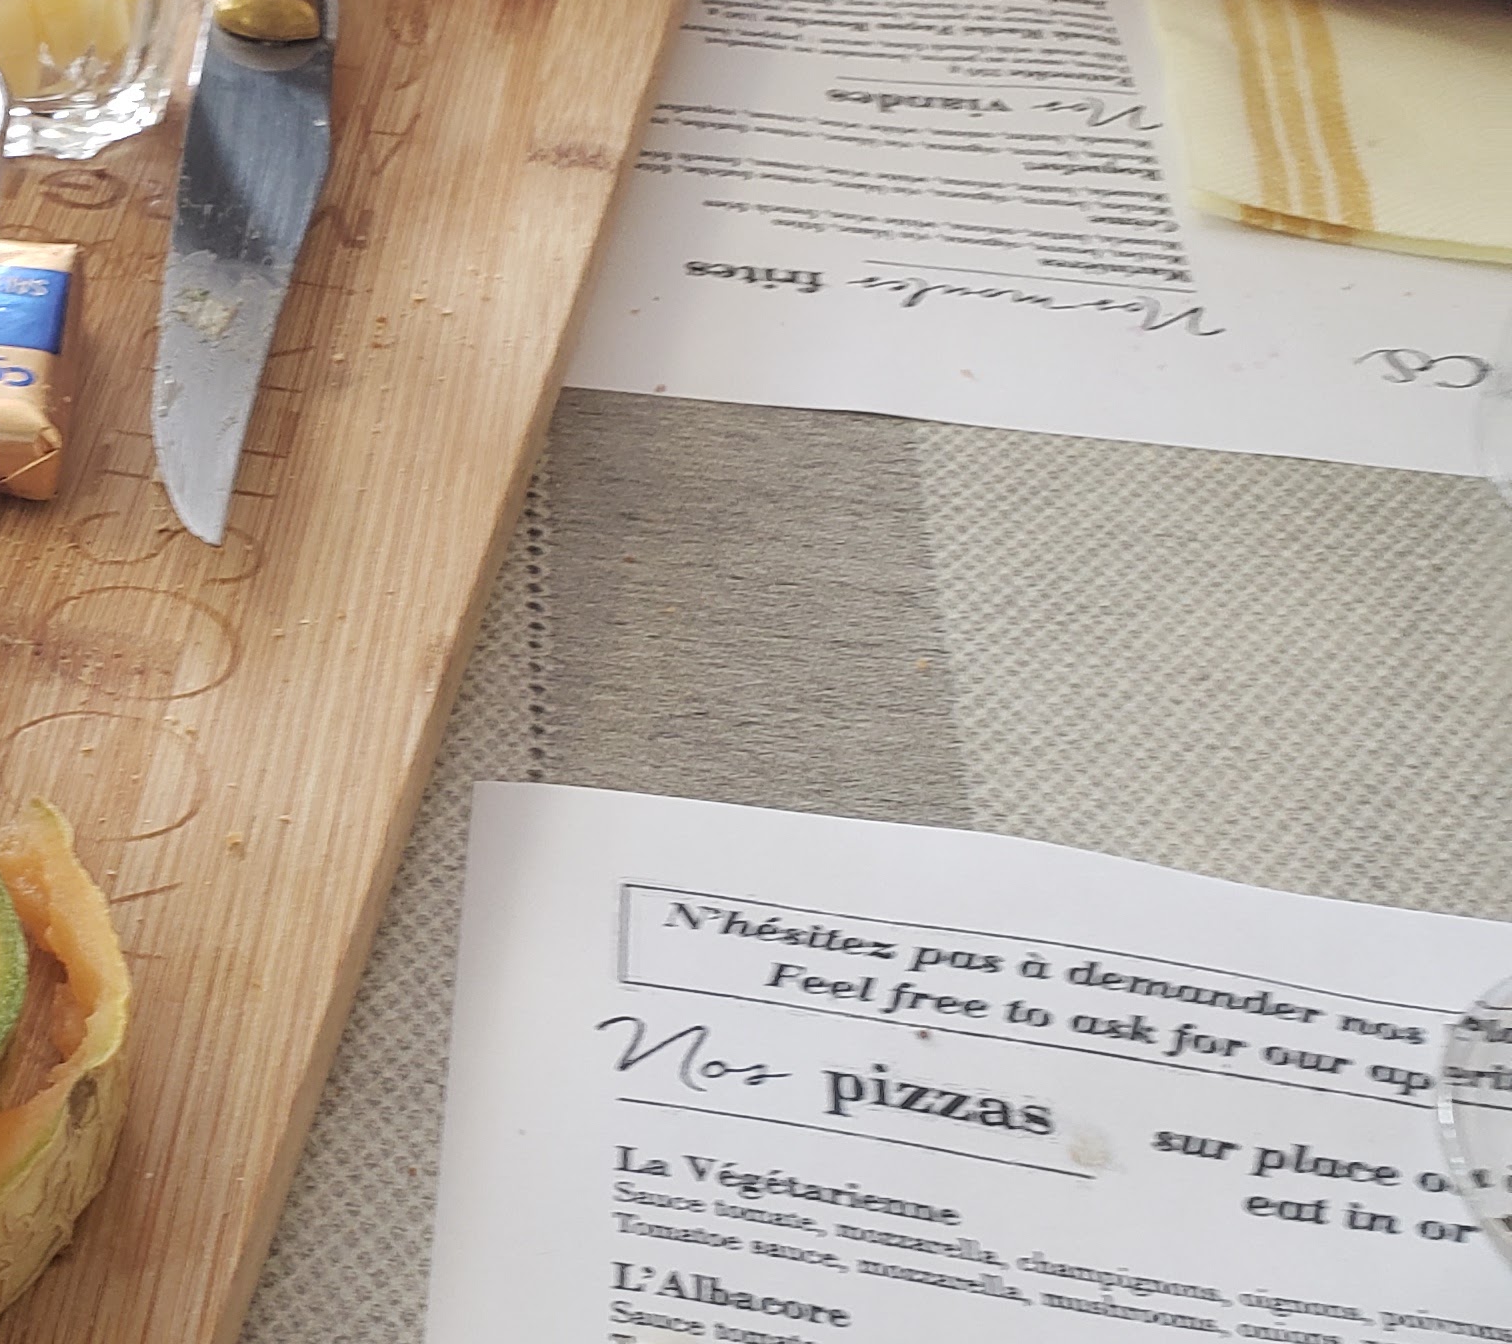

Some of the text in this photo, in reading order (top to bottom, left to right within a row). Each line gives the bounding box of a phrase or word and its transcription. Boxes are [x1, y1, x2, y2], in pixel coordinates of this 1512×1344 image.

[823, 87, 1011, 120] viandes
[683, 259, 824, 295] frites
[764, 961, 877, 1002] Feel
[878, 981, 988, 1020] free
[1005, 998, 1054, 1028] to
[1068, 1013, 1157, 1045] ask
[1162, 1023, 1249, 1059] for
[1260, 1043, 1355, 1075] our
[906, 946, 1006, 974] pas
[1019, 950, 1051, 979] à
[1066, 960, 1326, 1025] demander
[1337, 1012, 1430, 1045] nos
[594, 1015, 1056, 1138] Nos pizzas
[613, 1145, 963, 1226] La Végétarienne
[1150, 1129, 1241, 1161] sur
[1248, 1143, 1402, 1187] place
[611, 1180, 708, 1212] Sauce
[713, 1199, 829, 1237] tomate,
[1242, 1194, 1483, 1244] eat in or
[610, 1211, 744, 1251] Tomatoe
[749, 1238, 850, 1274] sauce,
[609, 1299, 707, 1337] Sauce
